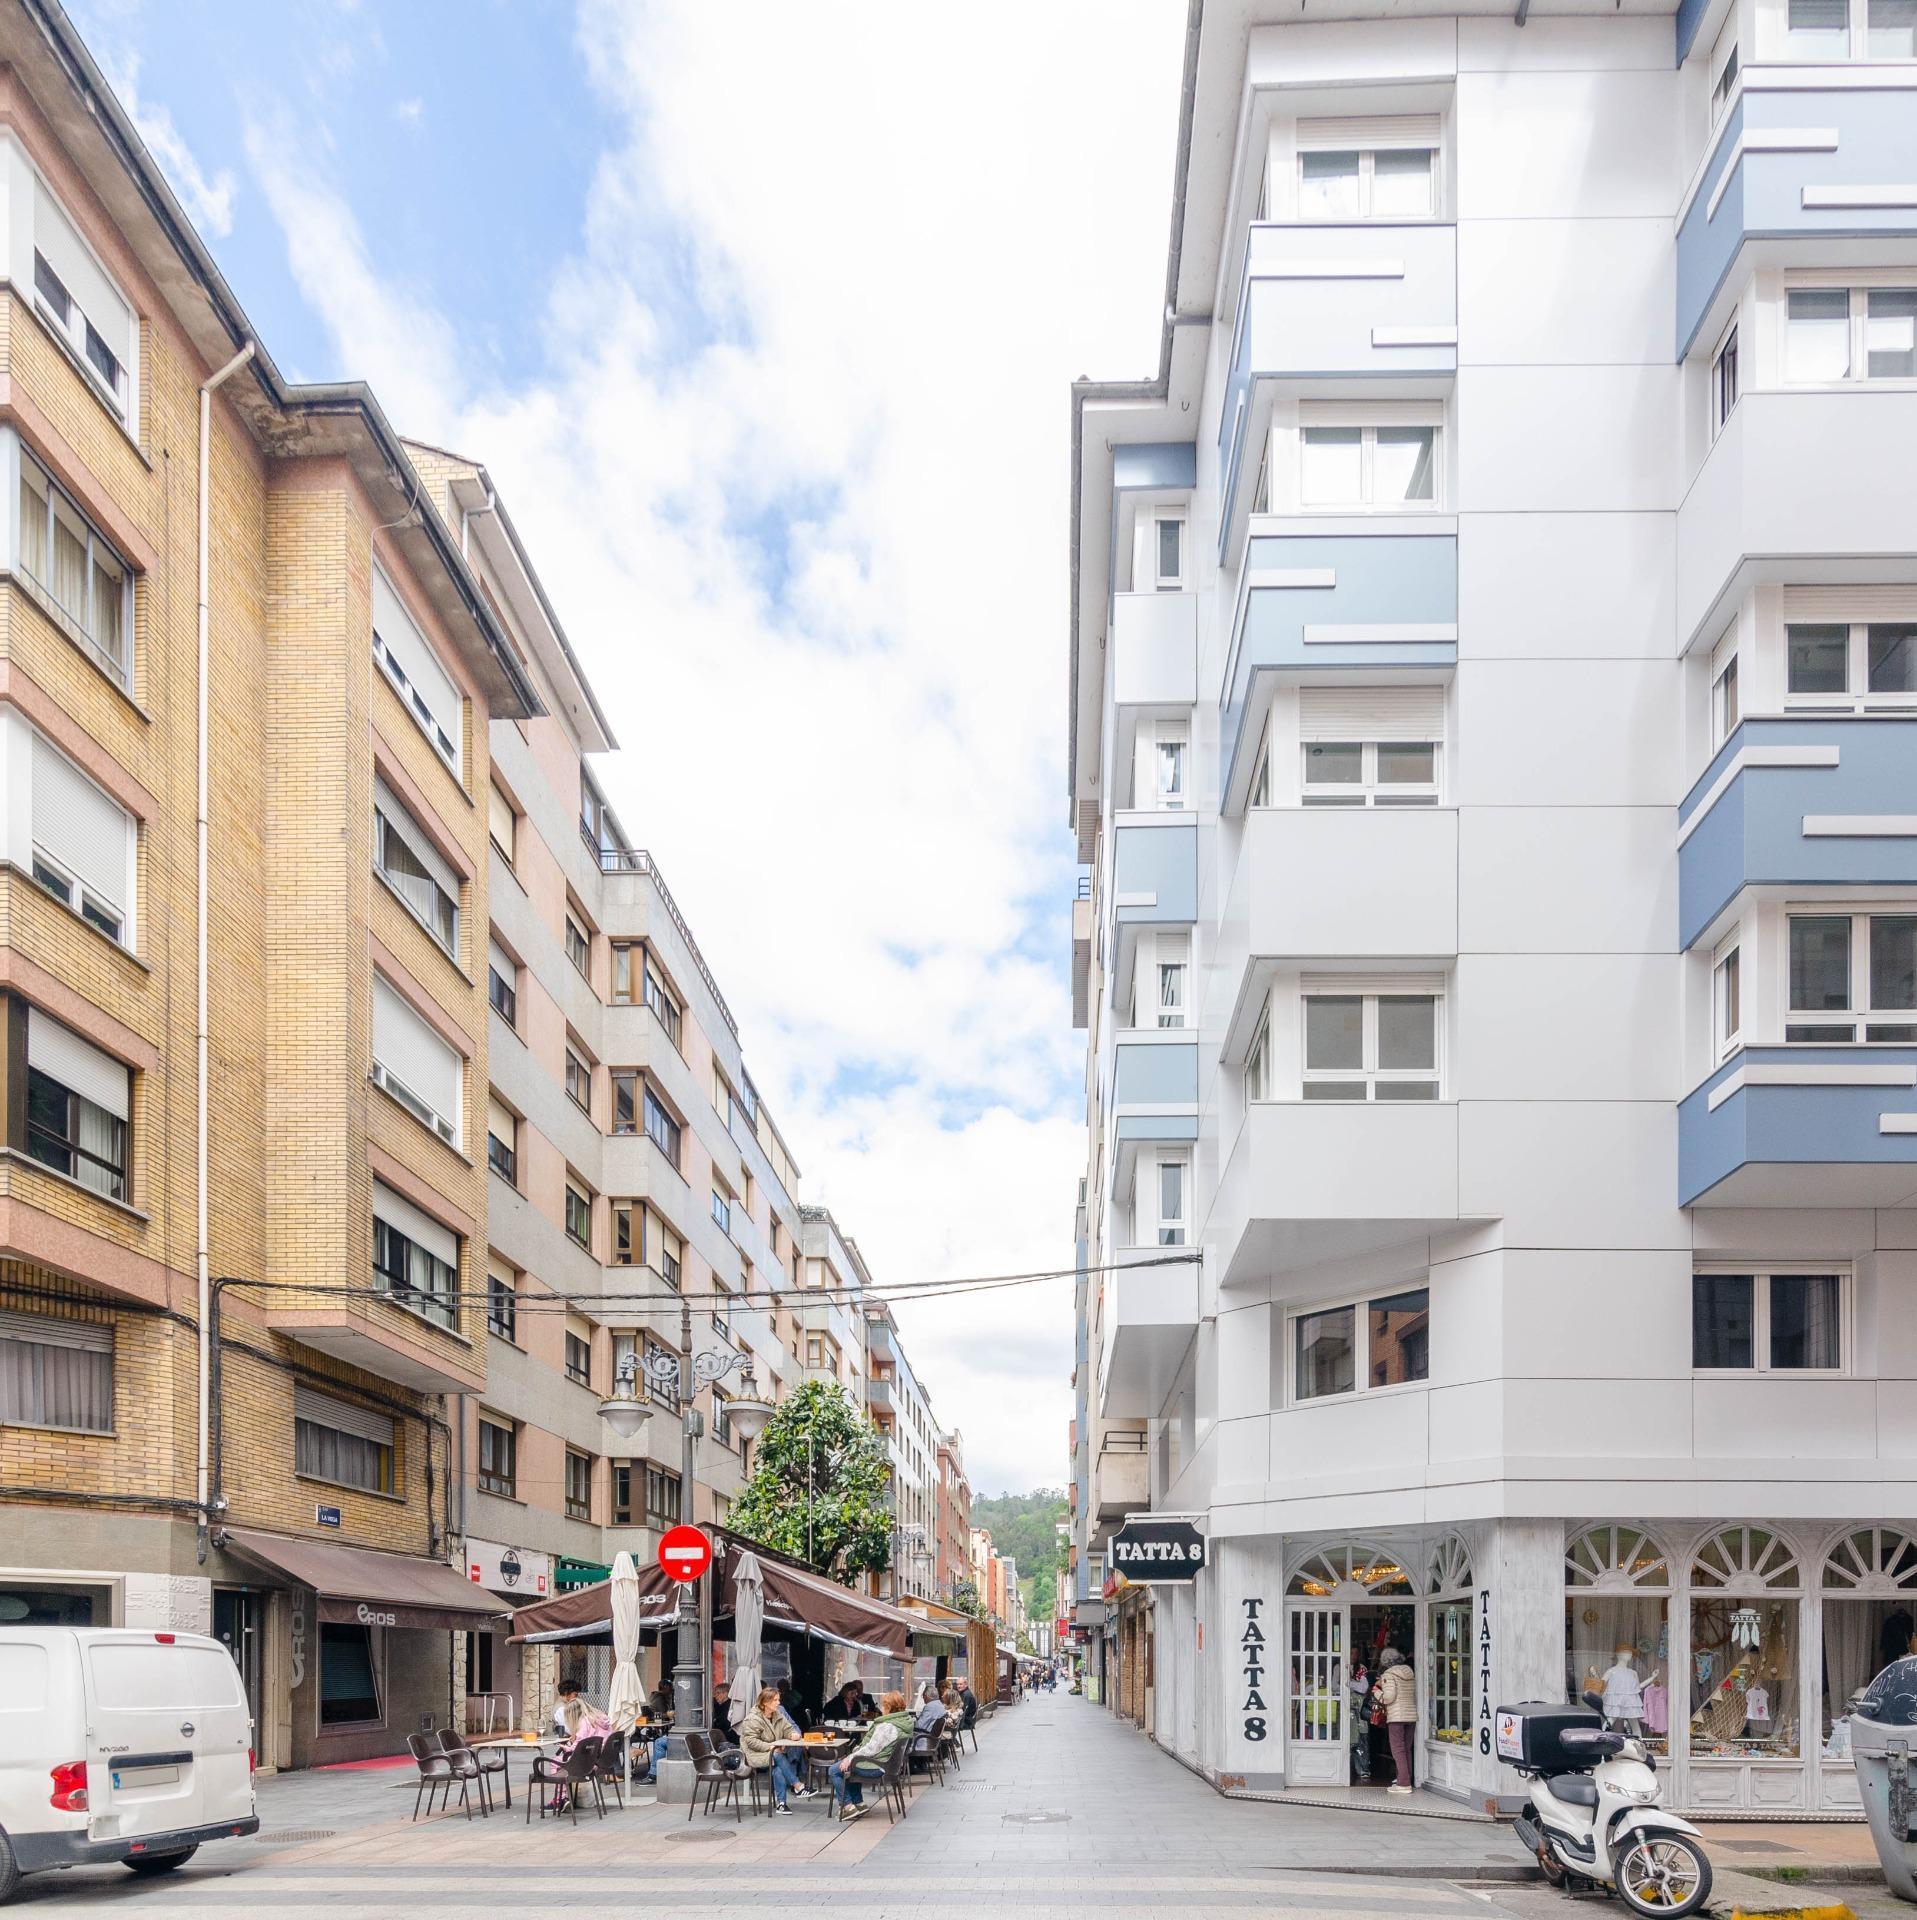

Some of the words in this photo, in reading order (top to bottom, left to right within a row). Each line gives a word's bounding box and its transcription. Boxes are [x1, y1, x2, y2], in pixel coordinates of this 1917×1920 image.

[1115, 1542, 1186, 1561] TATTA
[1189, 1543, 1202, 1560] 8
[1241, 1598, 1268, 1711] TATTA
[1479, 1590, 1492, 1720] TATTA
[1243, 1716, 1267, 1742] 8
[1479, 1726, 1491, 1756] 8
